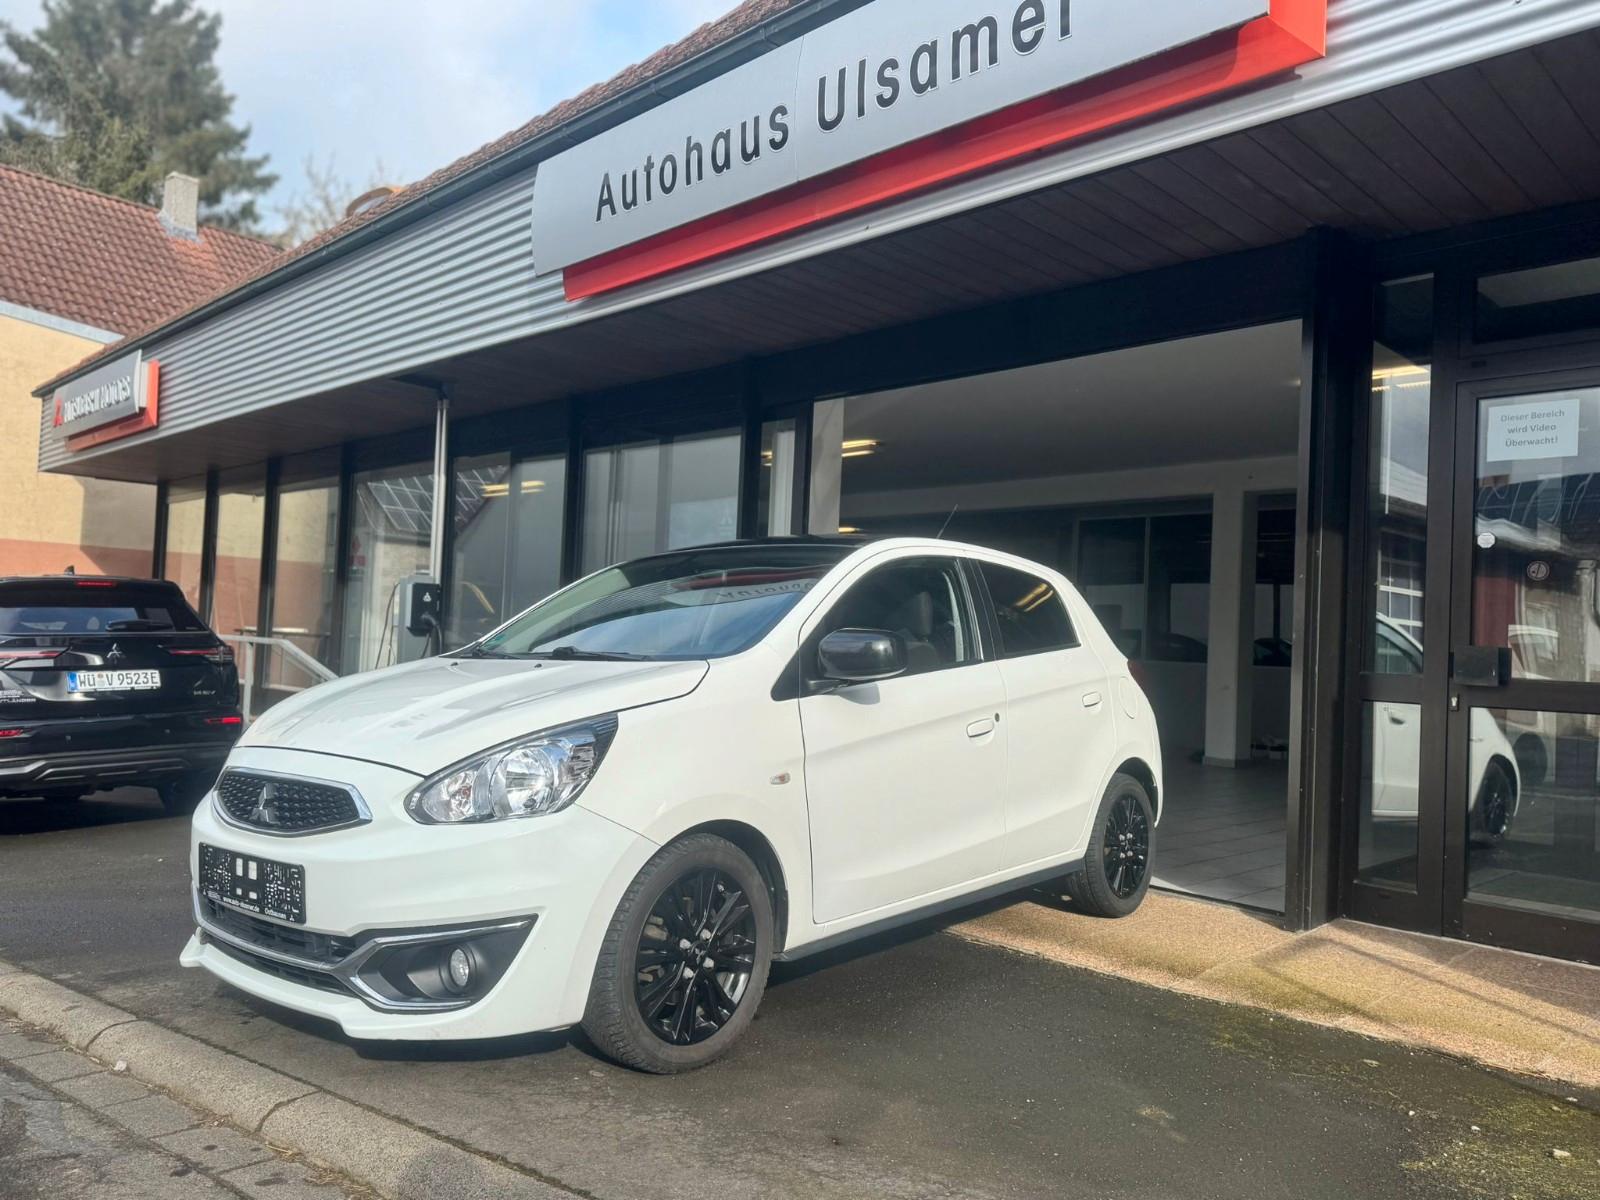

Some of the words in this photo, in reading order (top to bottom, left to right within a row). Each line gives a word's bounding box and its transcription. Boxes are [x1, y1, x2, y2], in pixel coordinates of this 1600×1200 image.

[595, 104, 789, 222] Autohaus
[1500, 413, 1529, 422] Dieser
[1530, 409, 1565, 420] Bereich
[1507, 424, 1528, 434] wird
[1530, 423, 1557, 433] Video
[1505, 435, 1558, 447] Überwacht!
[78, 673, 96, 687] WÜ
[105, 673, 114, 686] V
[117, 671, 158, 685] 9523E
